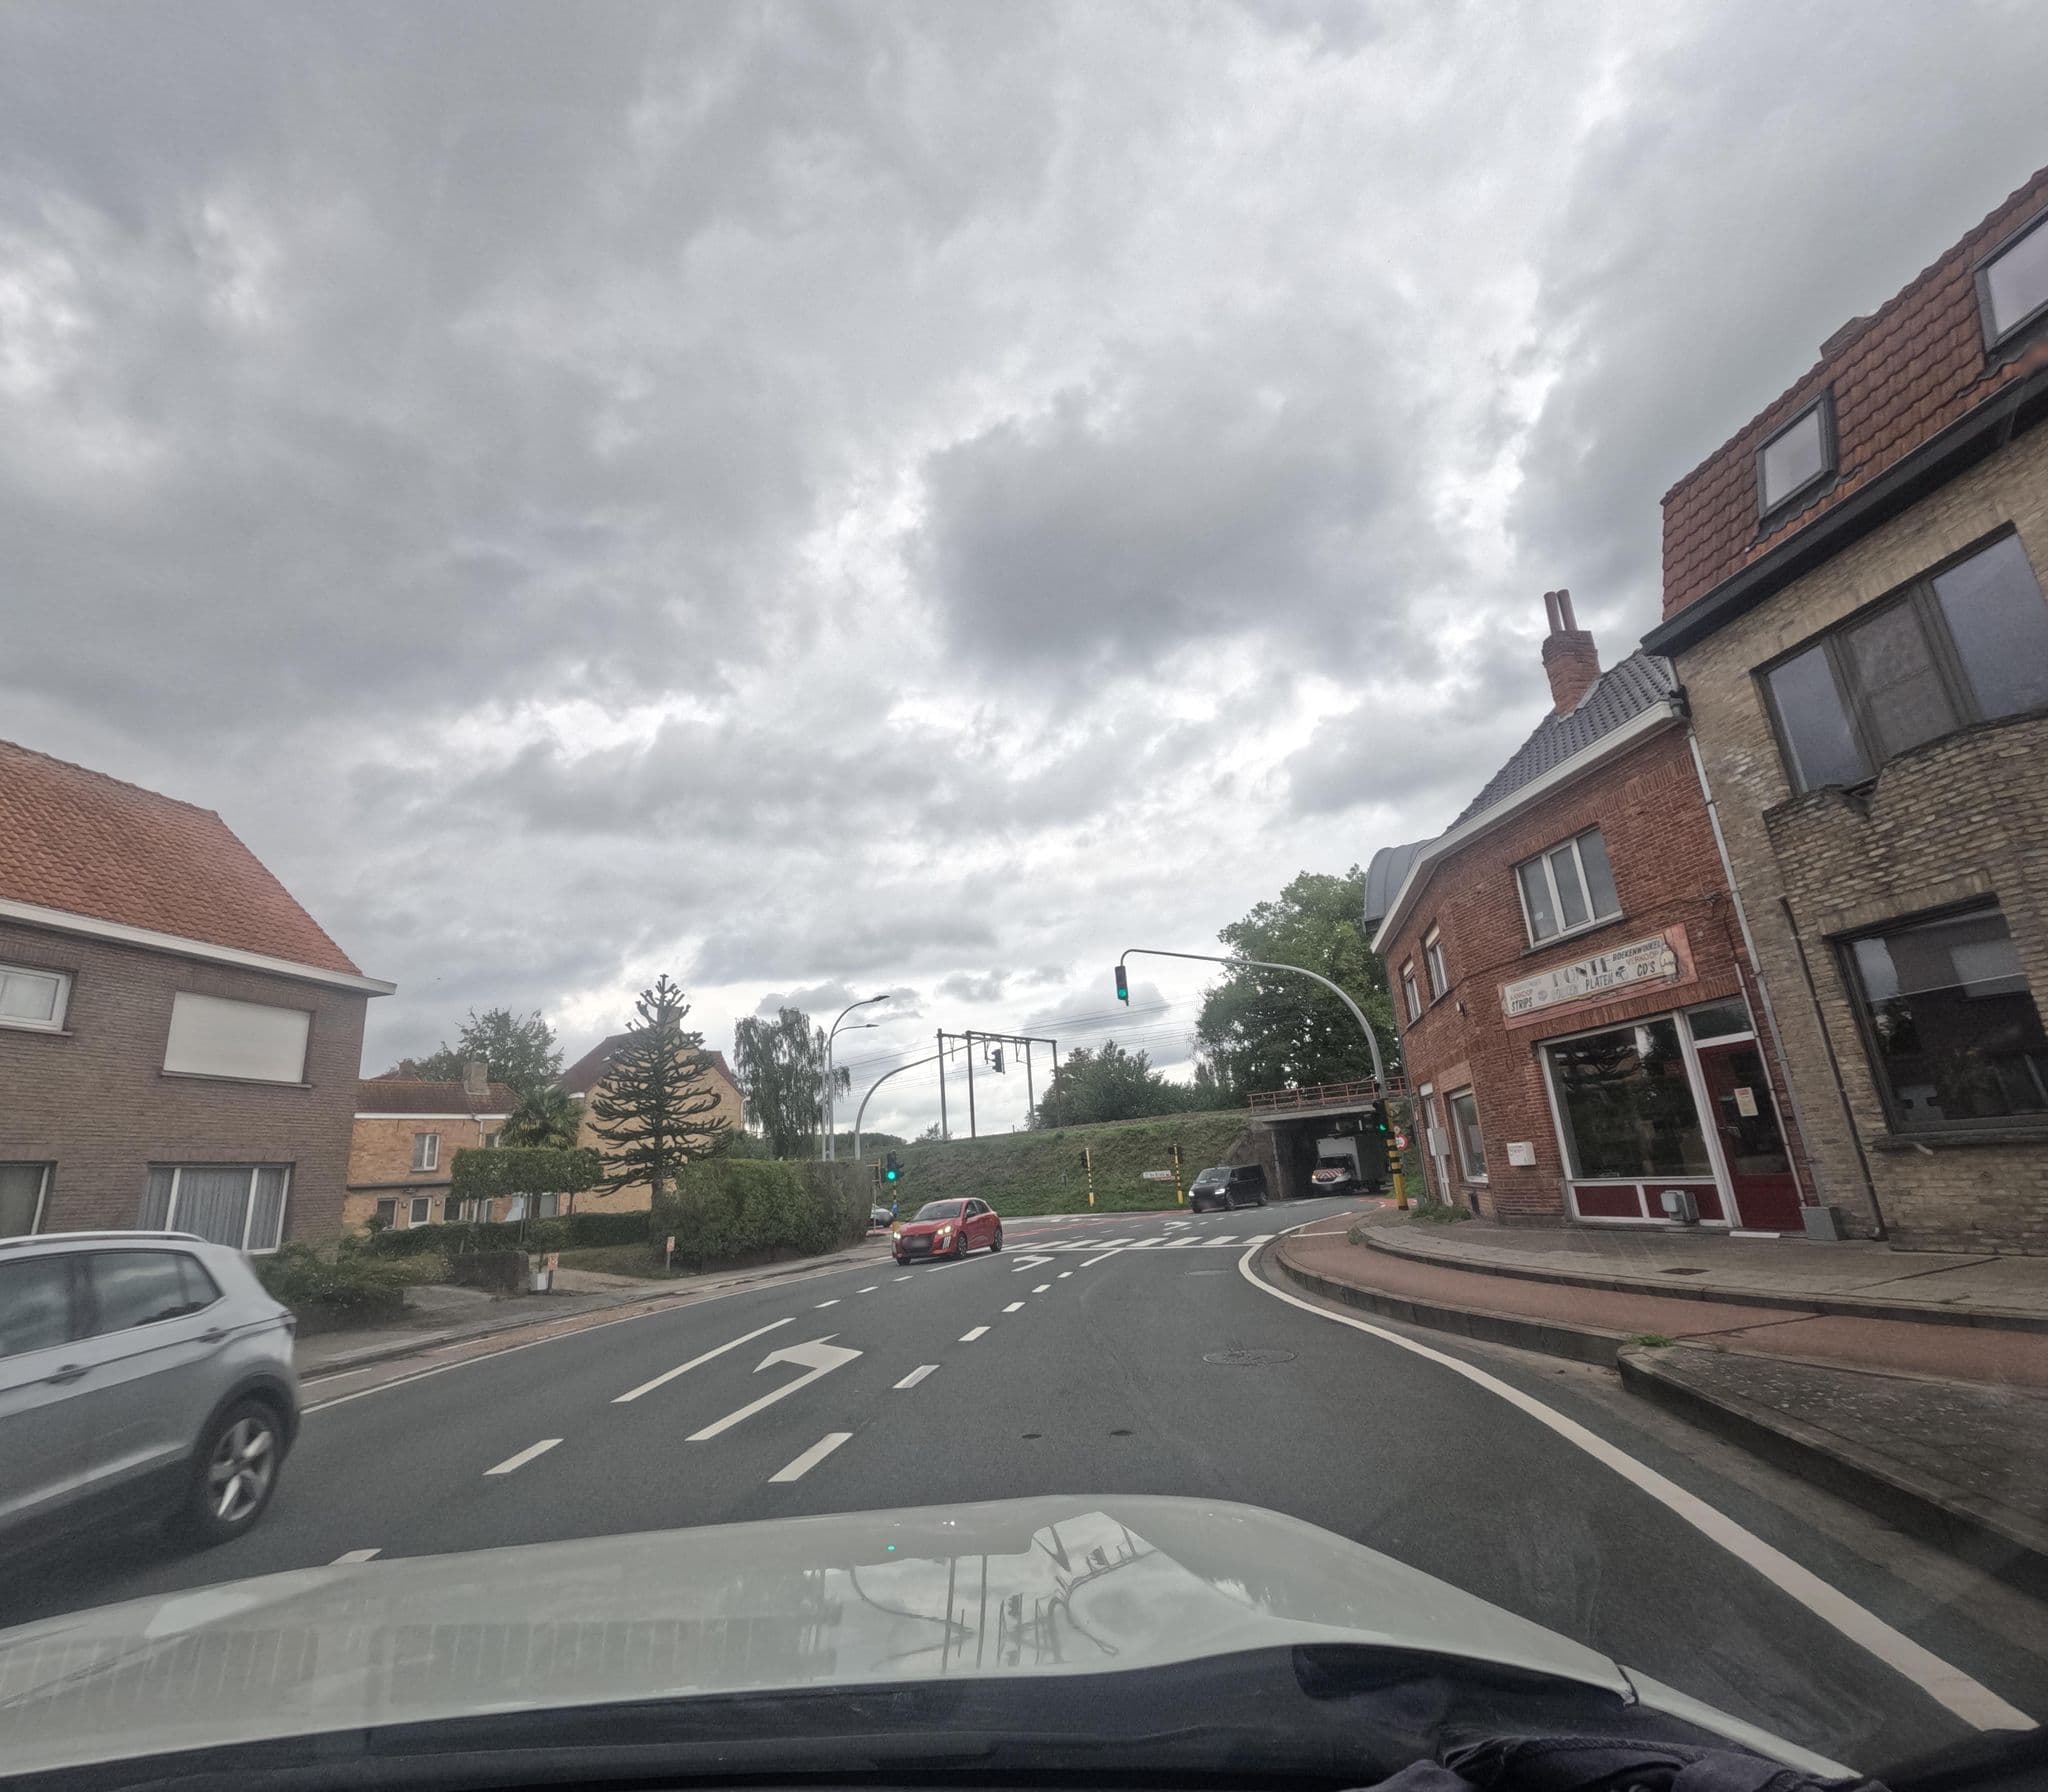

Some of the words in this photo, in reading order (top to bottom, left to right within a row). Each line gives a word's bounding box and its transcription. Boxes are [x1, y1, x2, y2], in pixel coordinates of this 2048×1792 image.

[1612, 940, 1661, 962] BOEKENWINKEL
[1626, 951, 1659, 966] VERKOOP
[1585, 973, 1614, 991] PLATEN
[1511, 997, 1533, 1012] STRIPS
